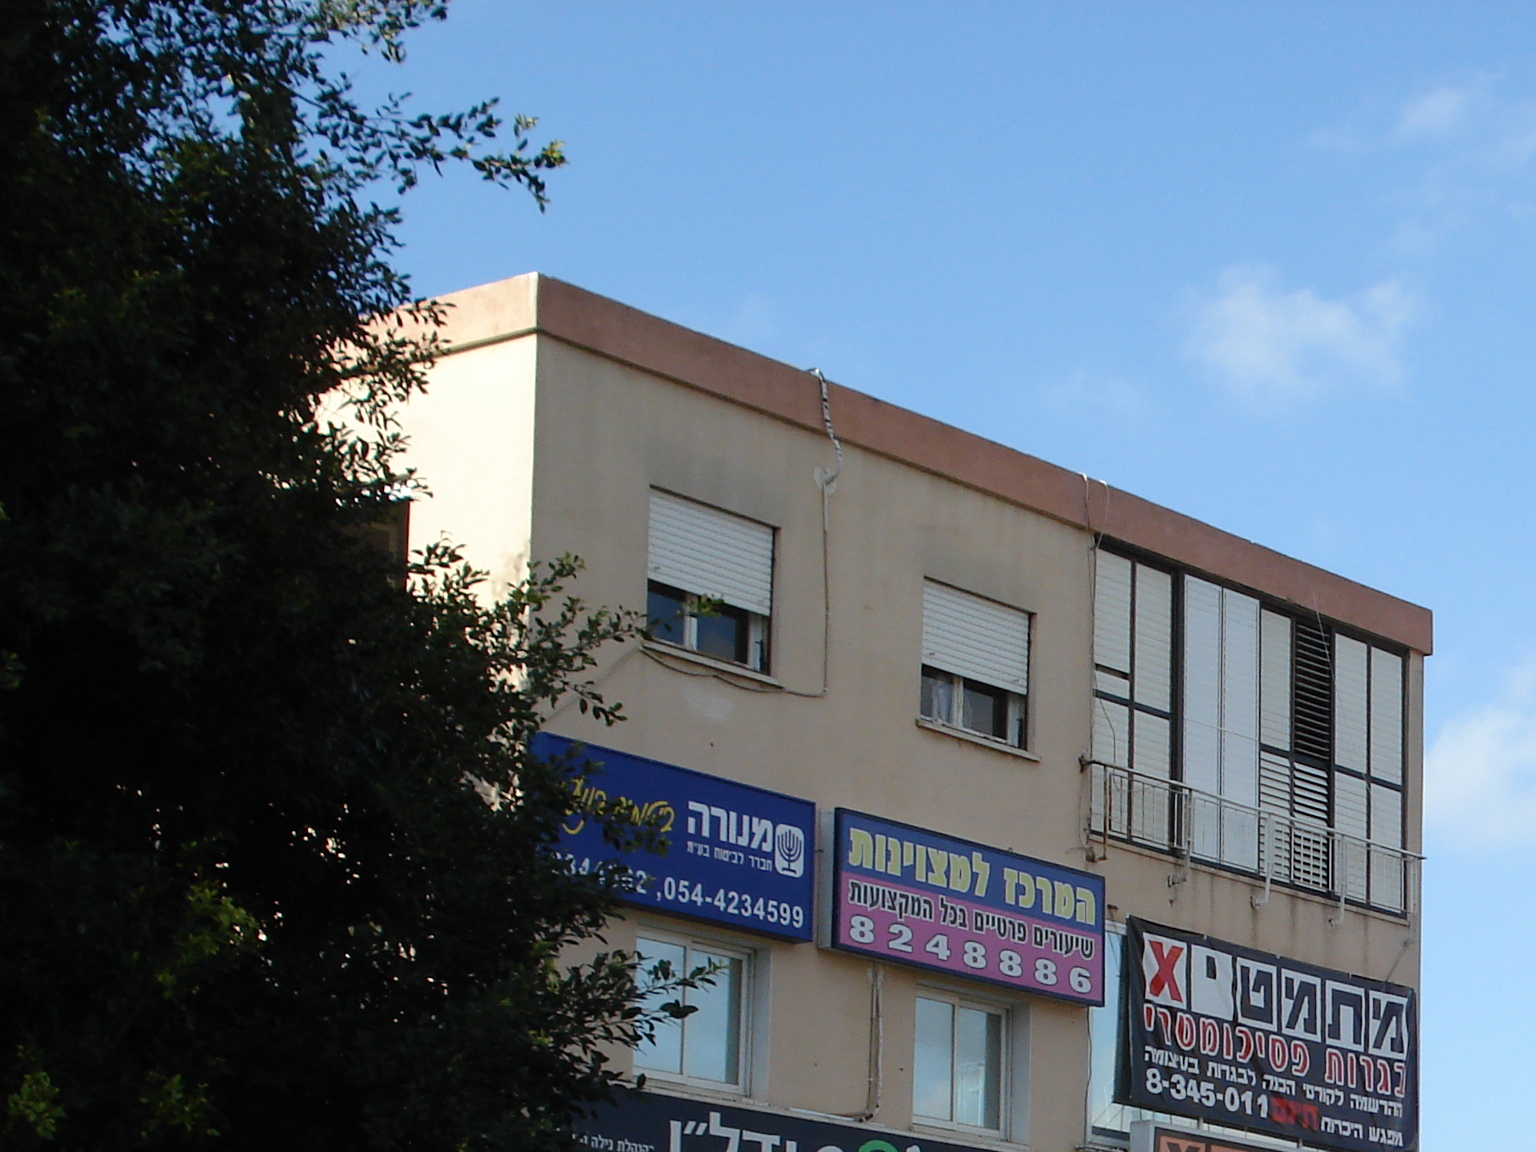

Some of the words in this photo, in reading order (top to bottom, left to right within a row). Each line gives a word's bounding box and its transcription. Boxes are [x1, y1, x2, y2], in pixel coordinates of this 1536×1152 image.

[688, 801, 773, 852] מנורה
[849, 828, 990, 897] למצוינות
[849, 880, 933, 921] המקצועות
[939, 895, 968, 930] בכל
[1004, 867, 1095, 925] המרכז
[973, 909, 1028, 942] פרטיים
[1032, 925, 1094, 961] שיעורים
[1143, 1003, 1309, 1077] פסיכומטרי
[1207, 1061, 1256, 1086] לבגרות
[1263, 1074, 1296, 1096] הכנה
[1146, 1069, 1269, 1118] 8-345-011
[1369, 1126, 1403, 1147] מפגש
